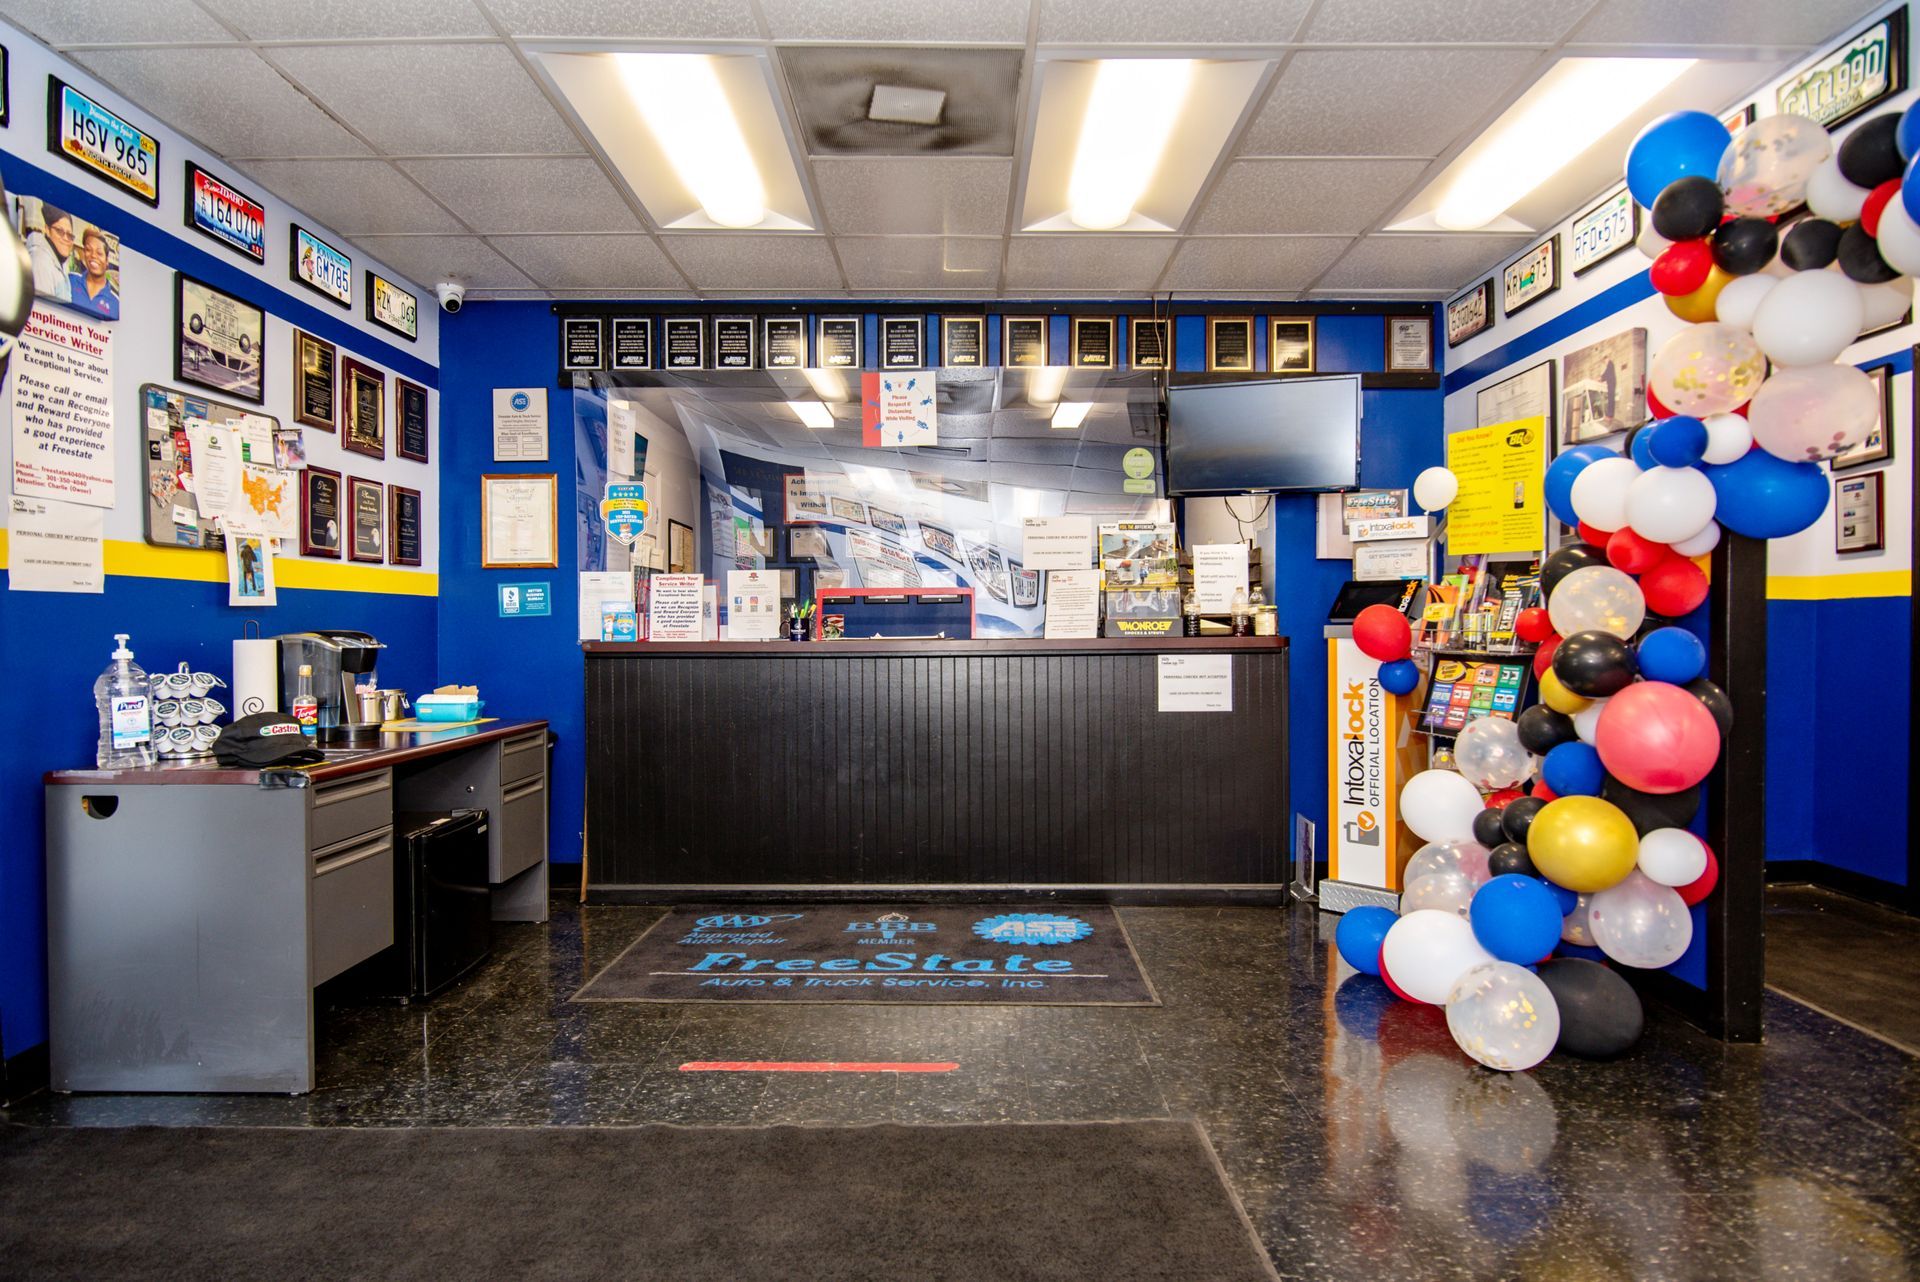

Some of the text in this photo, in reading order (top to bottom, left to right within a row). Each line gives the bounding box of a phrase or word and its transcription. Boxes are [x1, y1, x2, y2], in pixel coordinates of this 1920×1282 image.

[73, 109, 147, 176] HSV 965
[220, 187, 244, 207] IDAHO
[1604, 208, 1627, 242] 575
[317, 244, 334, 263] IOWA
[316, 256, 349, 292] GM785
[32, 310, 109, 344] mpliment Your
[24, 321, 103, 356] Service Writer
[18, 340, 109, 375] We want to hear about
[24, 354, 104, 384] Exceptional Service.
[19, 374, 108, 406] Please call or email
[17, 388, 110, 417] so we can Recognize
[16, 401, 111, 430] and Reward Everyone
[25, 415, 103, 439] who has provided
[33, 429, 57, 440] good
[59, 435, 105, 451] experience
[38, 442, 93, 460] at Freestate
[47, 482, 68, 491] Charlie
[1347, 495, 1398, 507] FreeState
[16, 530, 43, 539] PERSONAL
[45, 532, 63, 540] CHECKS
[1370, 521, 1416, 532] Intoxalock
[1120, 621, 1170, 631] MONROE
[1343, 681, 1365, 806] Intoxalock
[1369, 677, 1380, 807] OFFICIAL LOCATION
[698, 915, 770, 929] AAA
[846, 921, 937, 932] BBB
[989, 921, 1077, 933] ASE
[677, 937, 788, 946] Auto Repair
[684, 931, 775, 940] Approved
[687, 951, 1074, 972] FreeState
[699, 977, 1050, 988] Auto & Truck Service, Inc.
